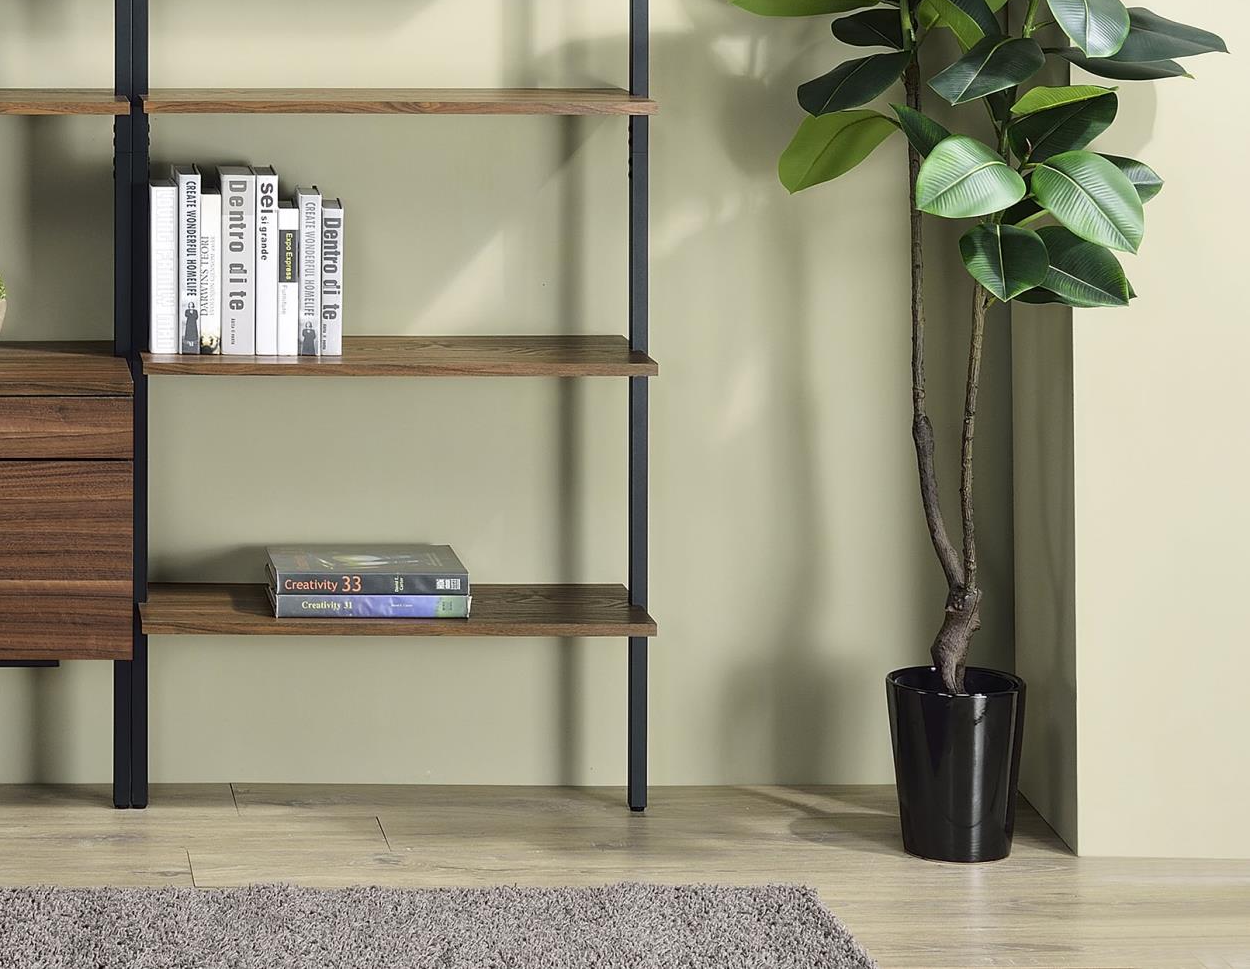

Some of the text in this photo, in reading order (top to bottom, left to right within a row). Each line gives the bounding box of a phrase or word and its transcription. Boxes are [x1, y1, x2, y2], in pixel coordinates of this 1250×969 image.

[186, 180, 197, 297] CREATE WONDERFUL HOMELIFE
[261, 215, 269, 224] si
[229, 180, 248, 311] Dentro di te
[259, 226, 270, 261] grande
[284, 232, 293, 280] Expo Express
[304, 201, 316, 317] CREATE WONDERFUL HOMELIFE
[323, 217, 342, 320] Dentro di te
[200, 269, 209, 316] DARWINS
[284, 575, 362, 592] Creativity 33
[301, 601, 353, 611] Creativity 31
